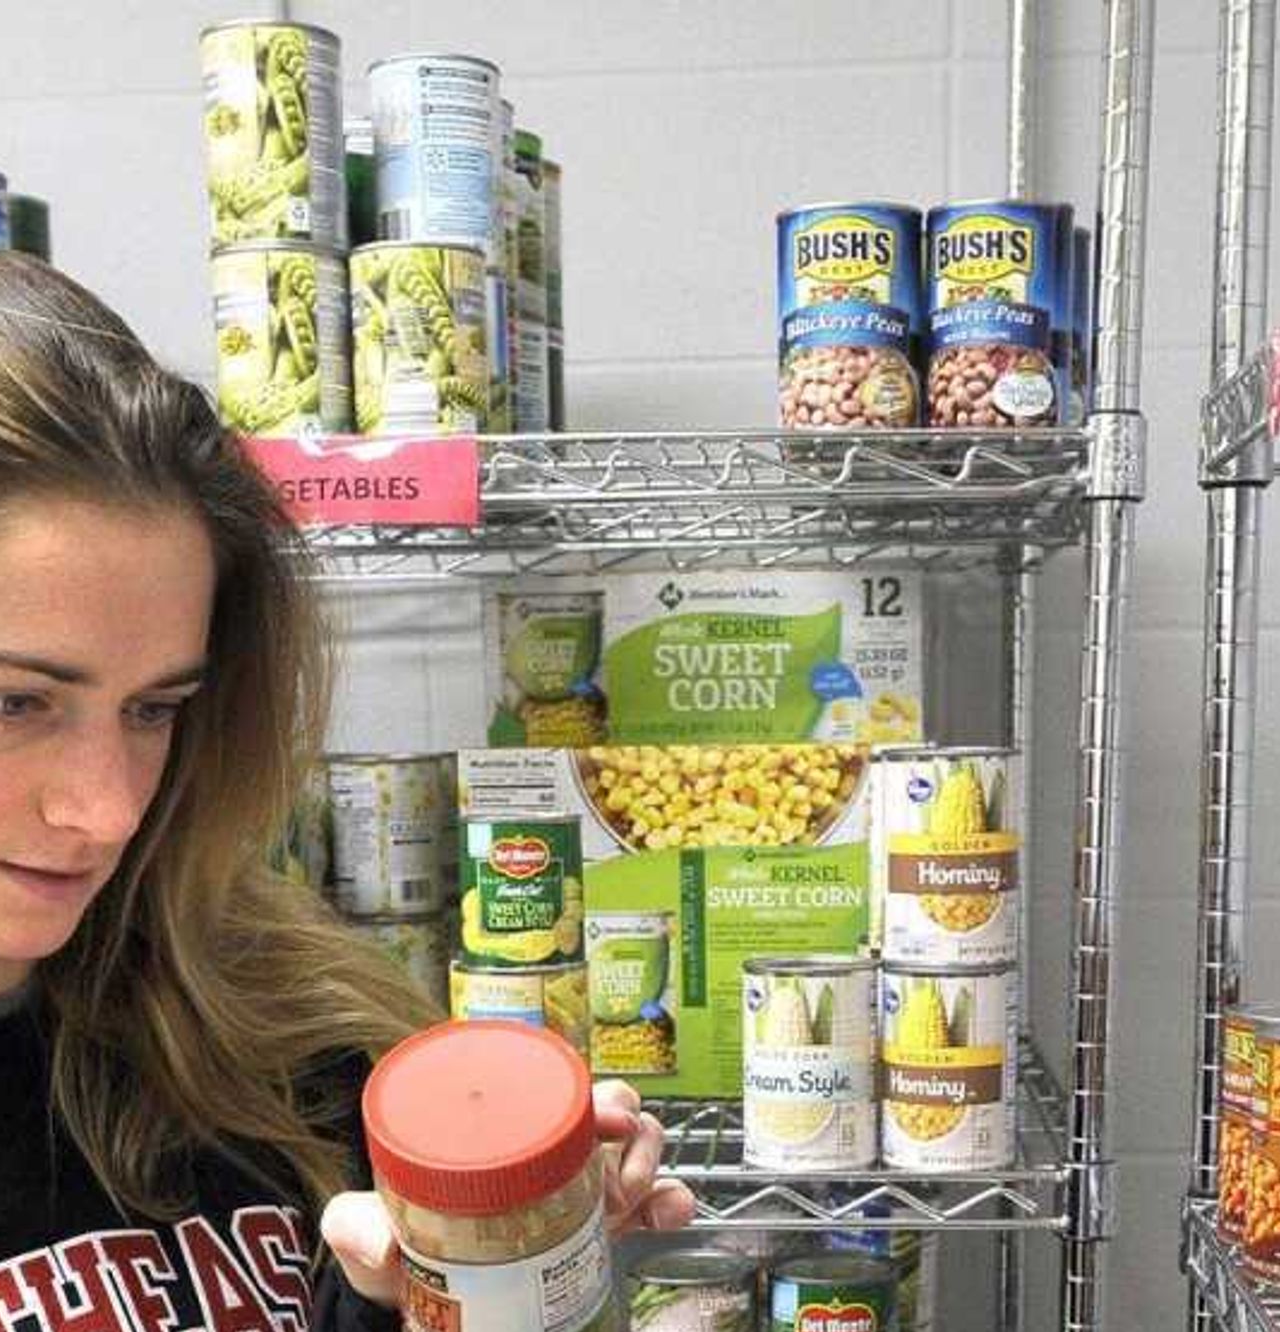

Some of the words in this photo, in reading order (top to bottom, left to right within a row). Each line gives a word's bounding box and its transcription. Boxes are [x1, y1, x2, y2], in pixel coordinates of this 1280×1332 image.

[797, 230, 891, 271] BUSH'S
[937, 229, 1027, 270] BUSH'S
[786, 314, 863, 338] Blackeye
[866, 315, 906, 337] Peas
[997, 305, 1035, 326] Peas
[278, 476, 420, 503] GETABLES
[860, 576, 903, 618] 12
[705, 618, 787, 638] KERNEL
[653, 643, 792, 677] SWEET
[669, 679, 777, 712] CORN
[770, 865, 846, 883] KERNEL
[917, 861, 1002, 890] Hominy
[707, 886, 792, 907] SWEET
[794, 886, 863, 907] CORN
[745, 1074, 794, 1094] ream
[798, 1069, 854, 1098] Style
[890, 1070, 966, 1102] Hominy
